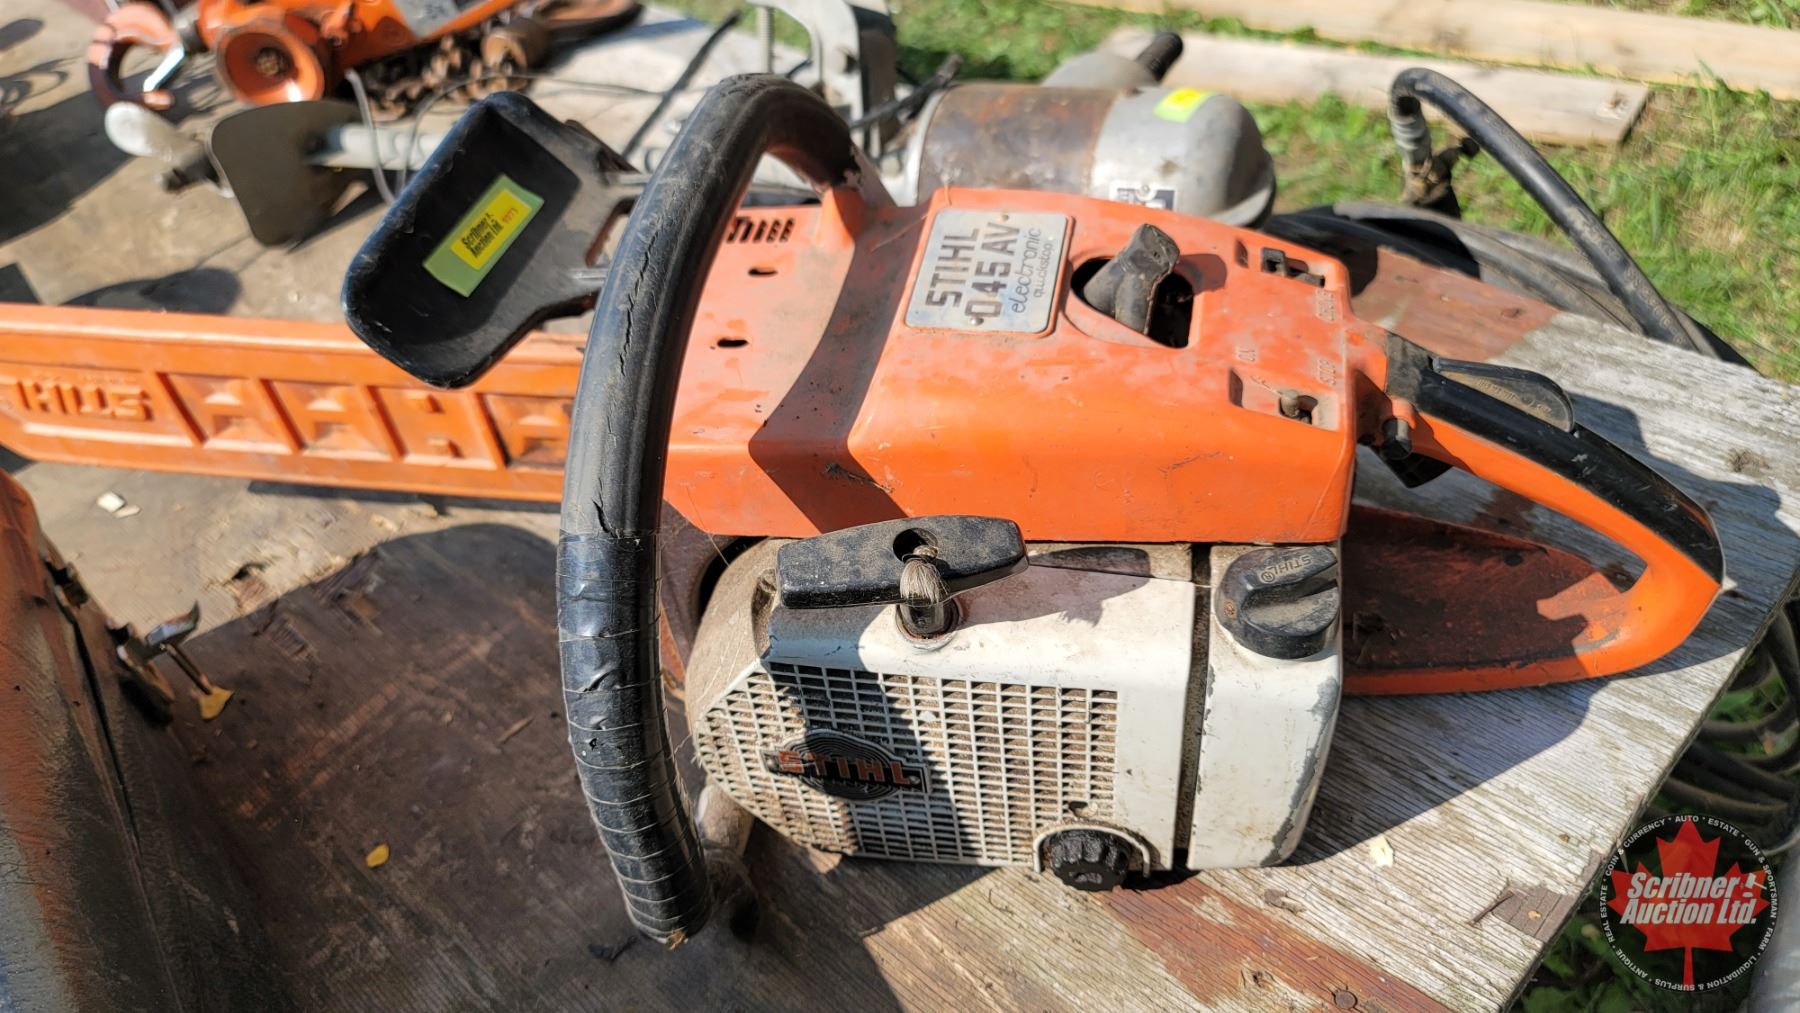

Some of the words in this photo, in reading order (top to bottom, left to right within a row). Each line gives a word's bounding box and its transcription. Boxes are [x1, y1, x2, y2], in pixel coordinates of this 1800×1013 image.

[925, 228, 980, 307] STIHL
[1008, 228, 1041, 313] electronic
[1033, 243, 1053, 298] quickstop
[778, 751, 911, 785] STIHL
